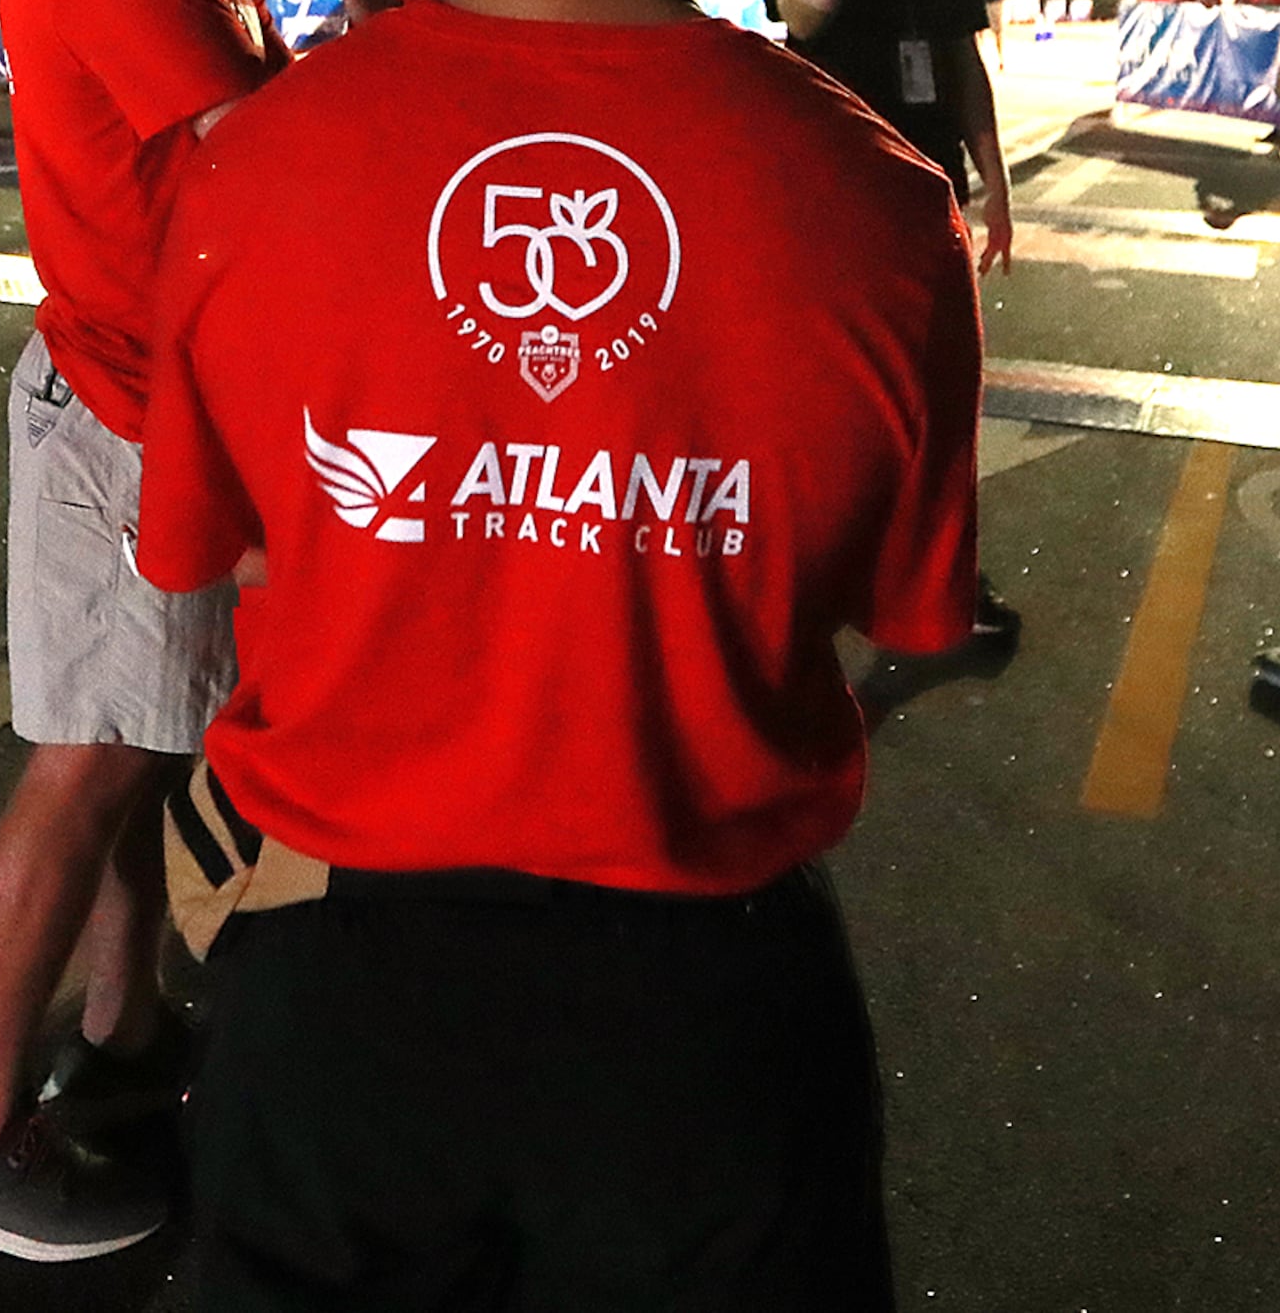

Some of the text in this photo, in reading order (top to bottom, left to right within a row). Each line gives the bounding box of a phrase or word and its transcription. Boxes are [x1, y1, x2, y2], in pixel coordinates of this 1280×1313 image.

[446, 303, 506, 364] 1970
[517, 344, 581, 361] PEACHTREE
[594, 312, 658, 372] 2019
[450, 441, 750, 524] ATLANTA
[450, 512, 745, 557] TRACK CLUB
